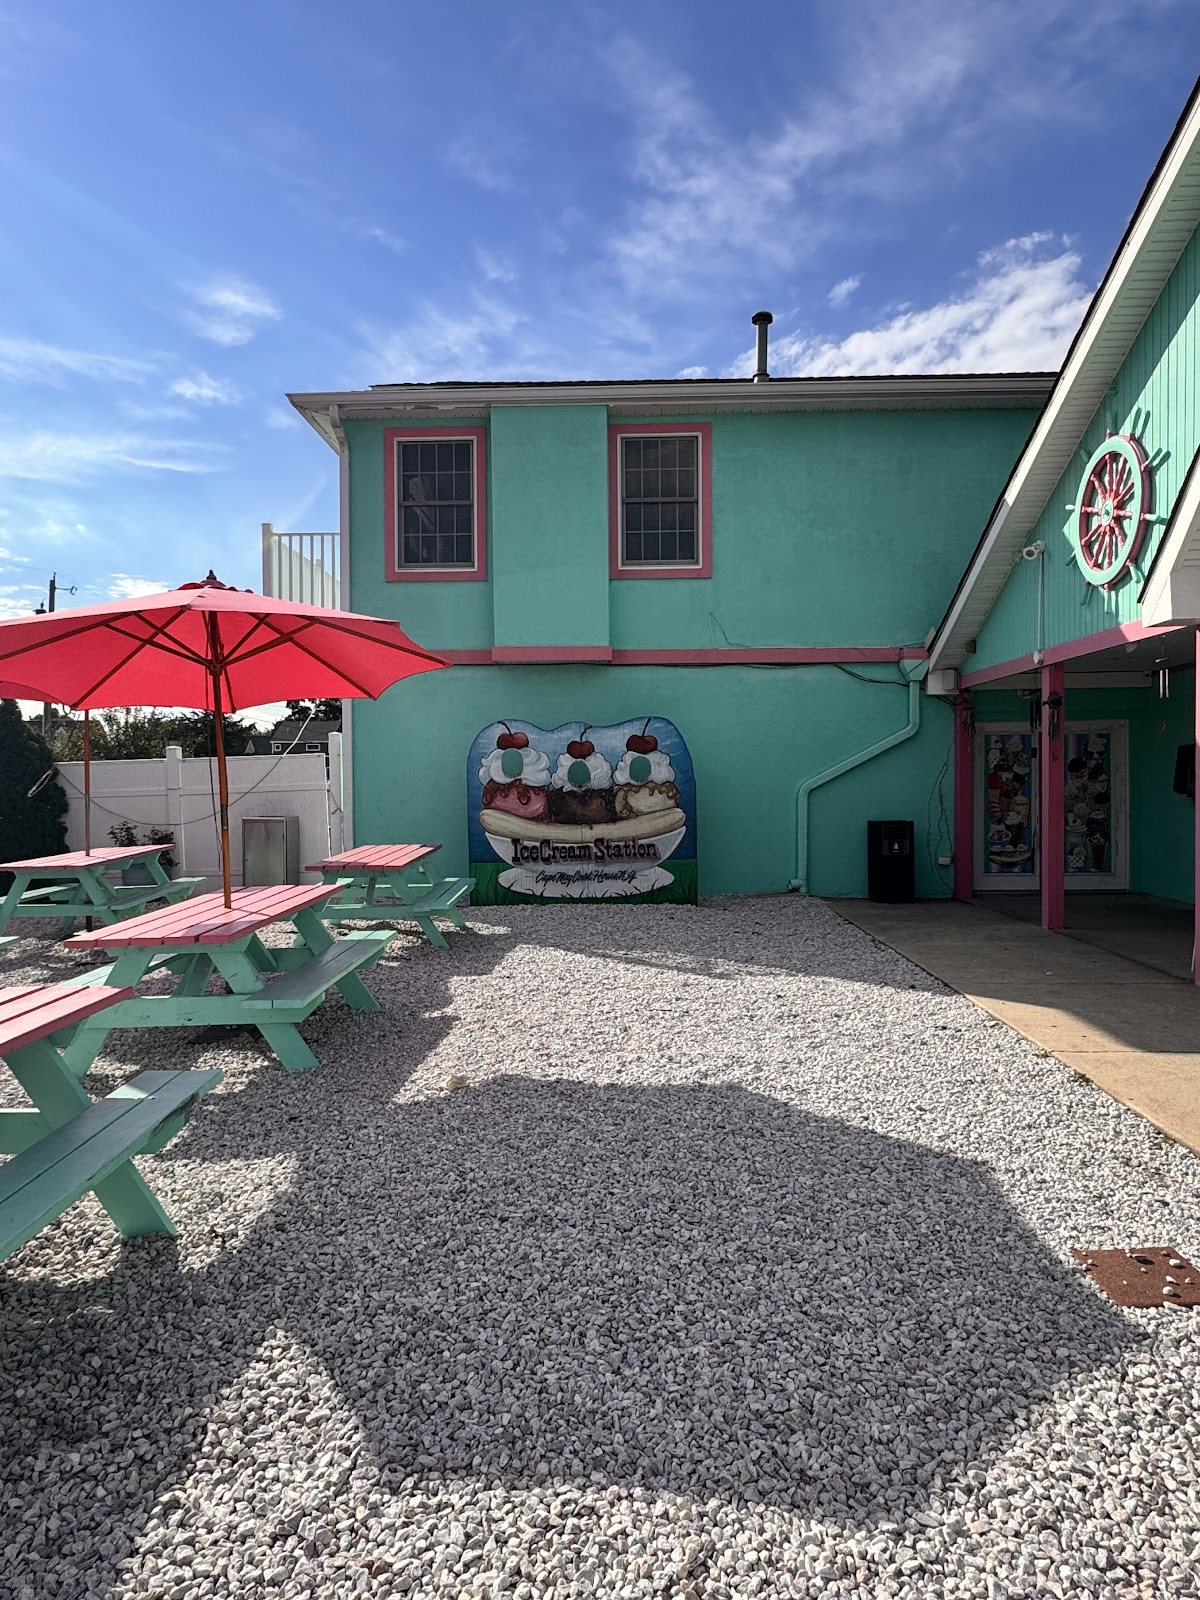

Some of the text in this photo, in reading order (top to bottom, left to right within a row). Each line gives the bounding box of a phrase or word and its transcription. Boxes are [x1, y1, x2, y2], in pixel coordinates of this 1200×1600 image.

[593, 837, 658, 863] Station
[535, 869, 557, 887] Cape
[556, 871, 573, 887] May
